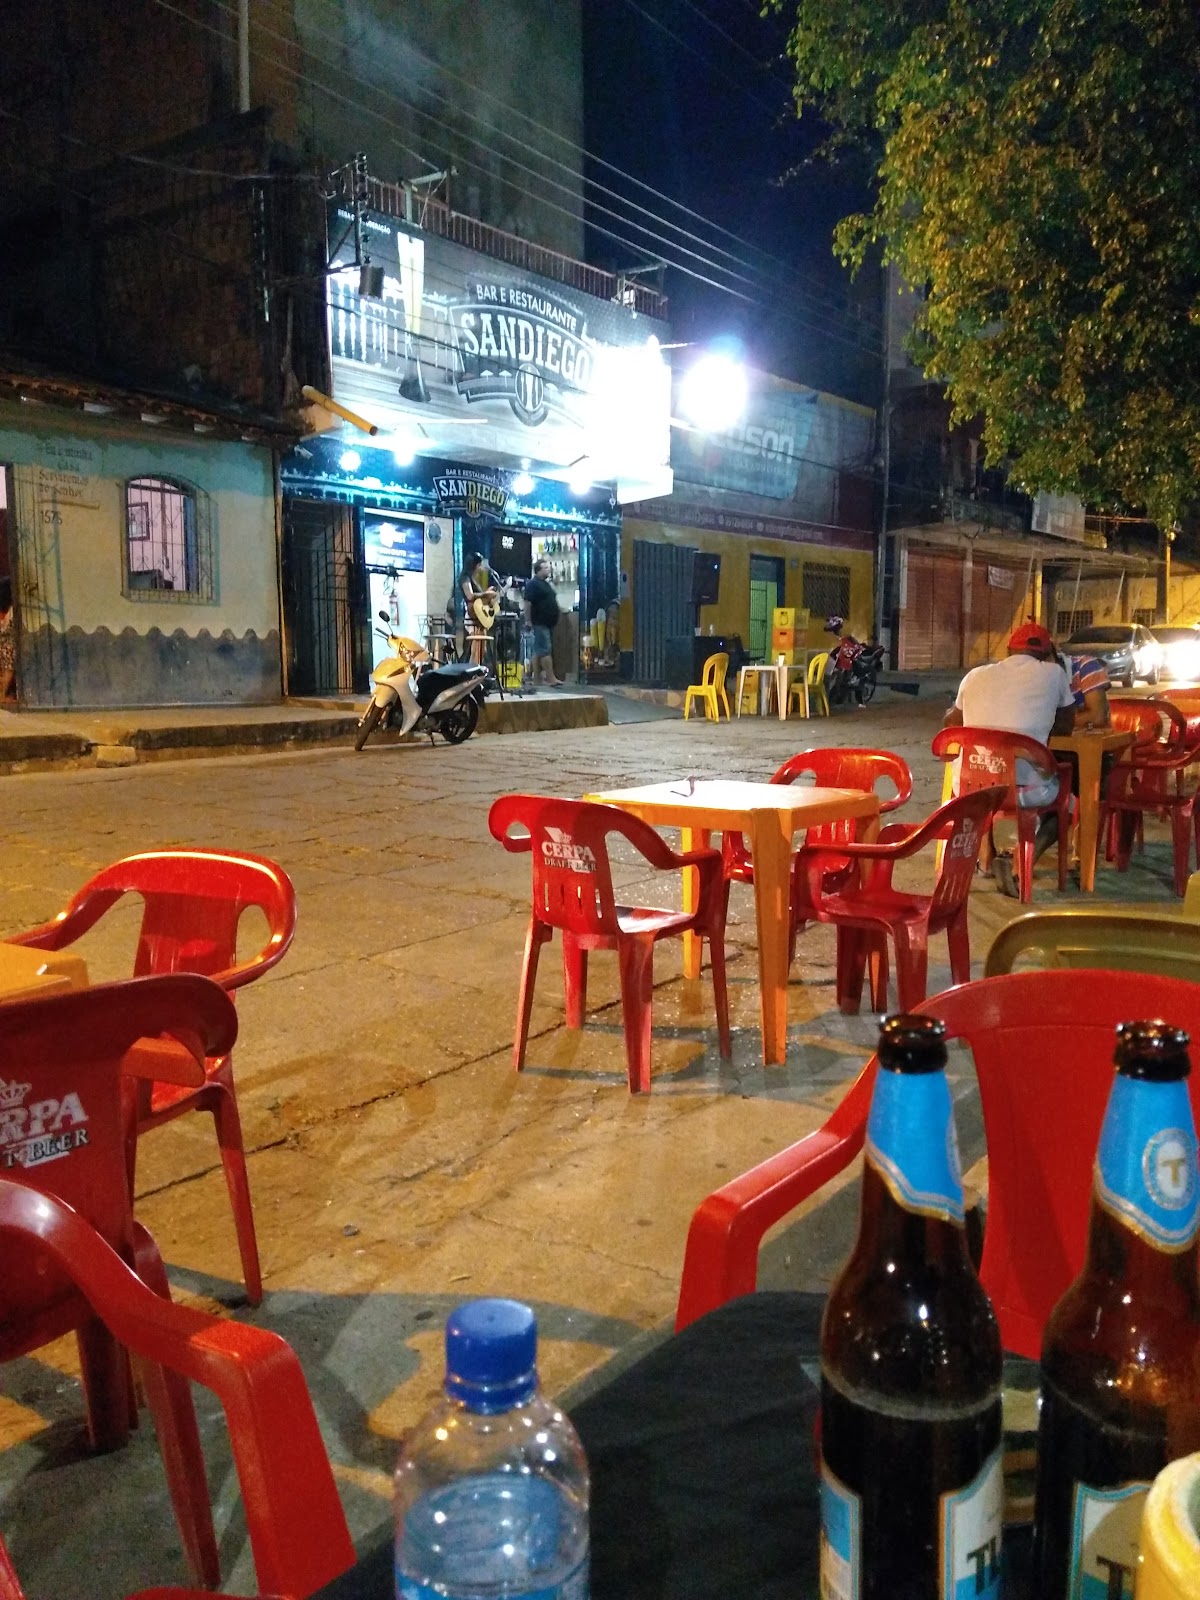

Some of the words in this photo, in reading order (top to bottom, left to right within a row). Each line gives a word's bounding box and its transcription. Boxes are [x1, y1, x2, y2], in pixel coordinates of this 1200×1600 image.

[476, 284, 498, 301] BAR
[500, 287, 507, 302] E
[509, 287, 577, 331] RESTAURANTE
[461, 312, 591, 389] SANDIEGO
[439, 479, 505, 506] SANDIEGO
[541, 841, 596, 861] CERPA
[1160, 1157, 1185, 1188] T
